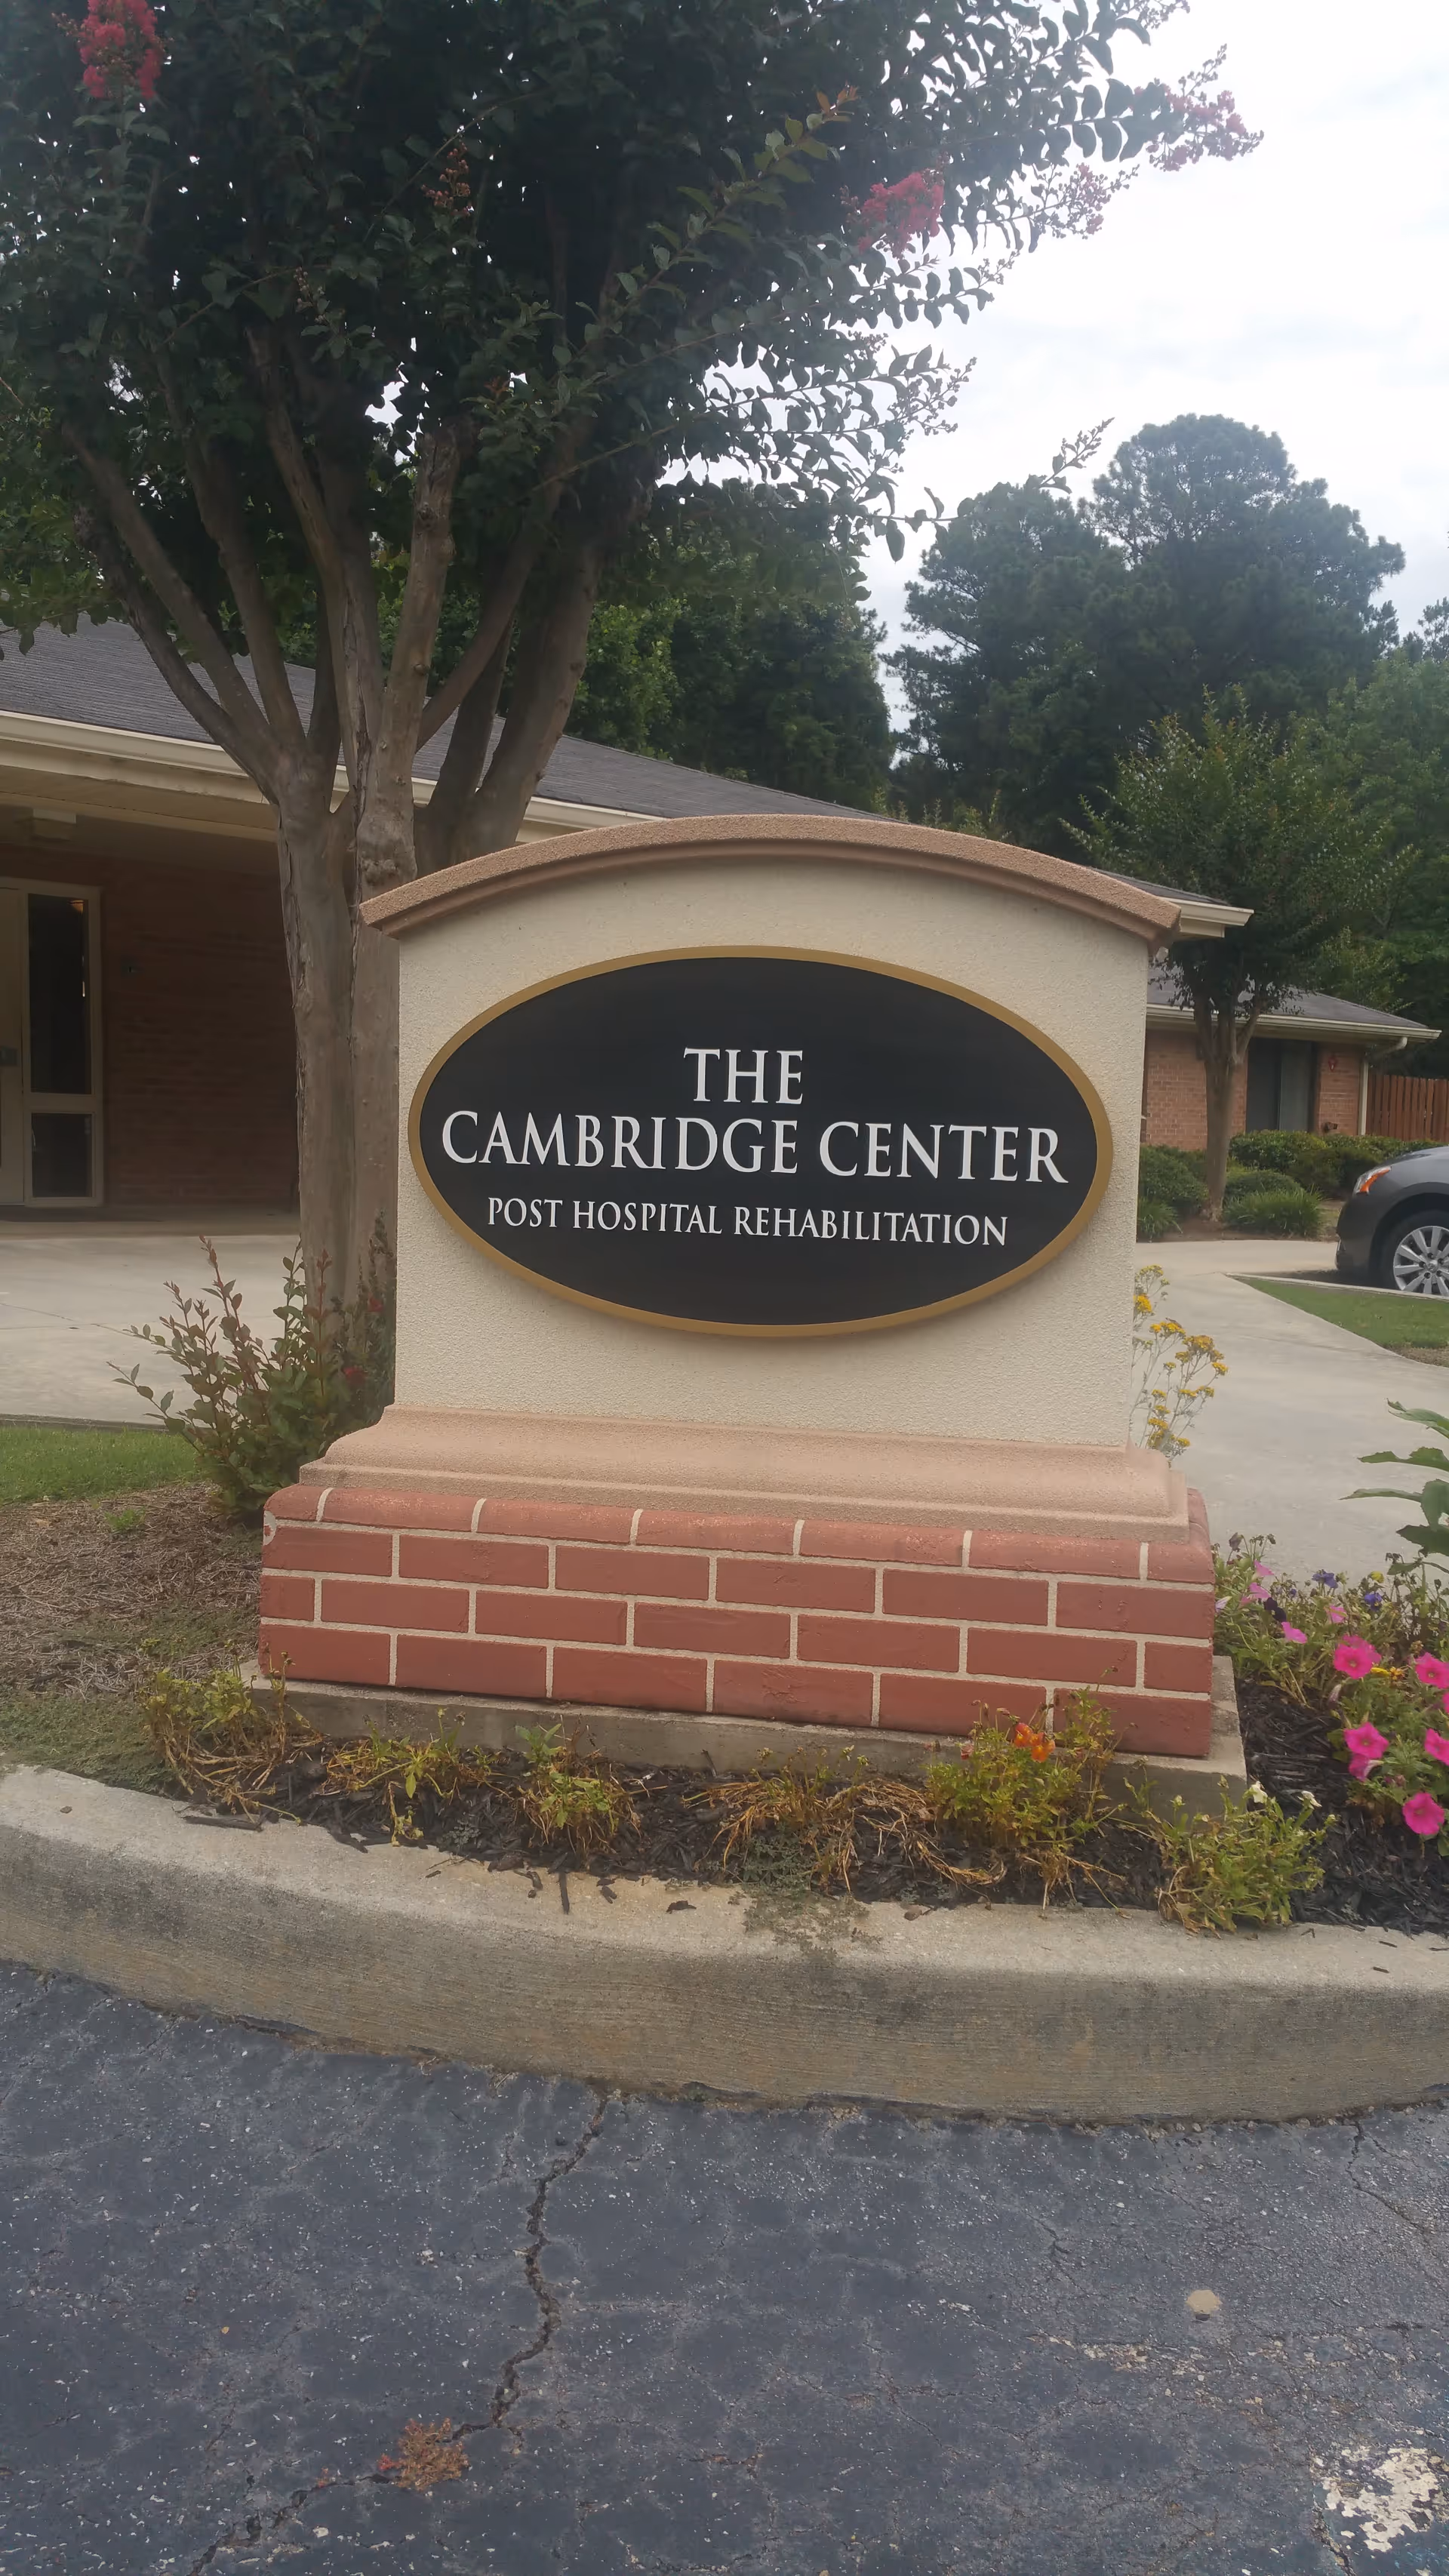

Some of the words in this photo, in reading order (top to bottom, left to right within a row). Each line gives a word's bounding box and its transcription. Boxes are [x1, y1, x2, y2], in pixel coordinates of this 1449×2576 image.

[683, 1048, 803, 1104] THE
[441, 1110, 798, 1174] CAMBRIDGE
[819, 1121, 1069, 1183] CENTER
[488, 1197, 563, 1228] POST
[573, 1200, 722, 1234] HOSPITAL
[734, 1206, 1008, 1246] REHABILITATION
